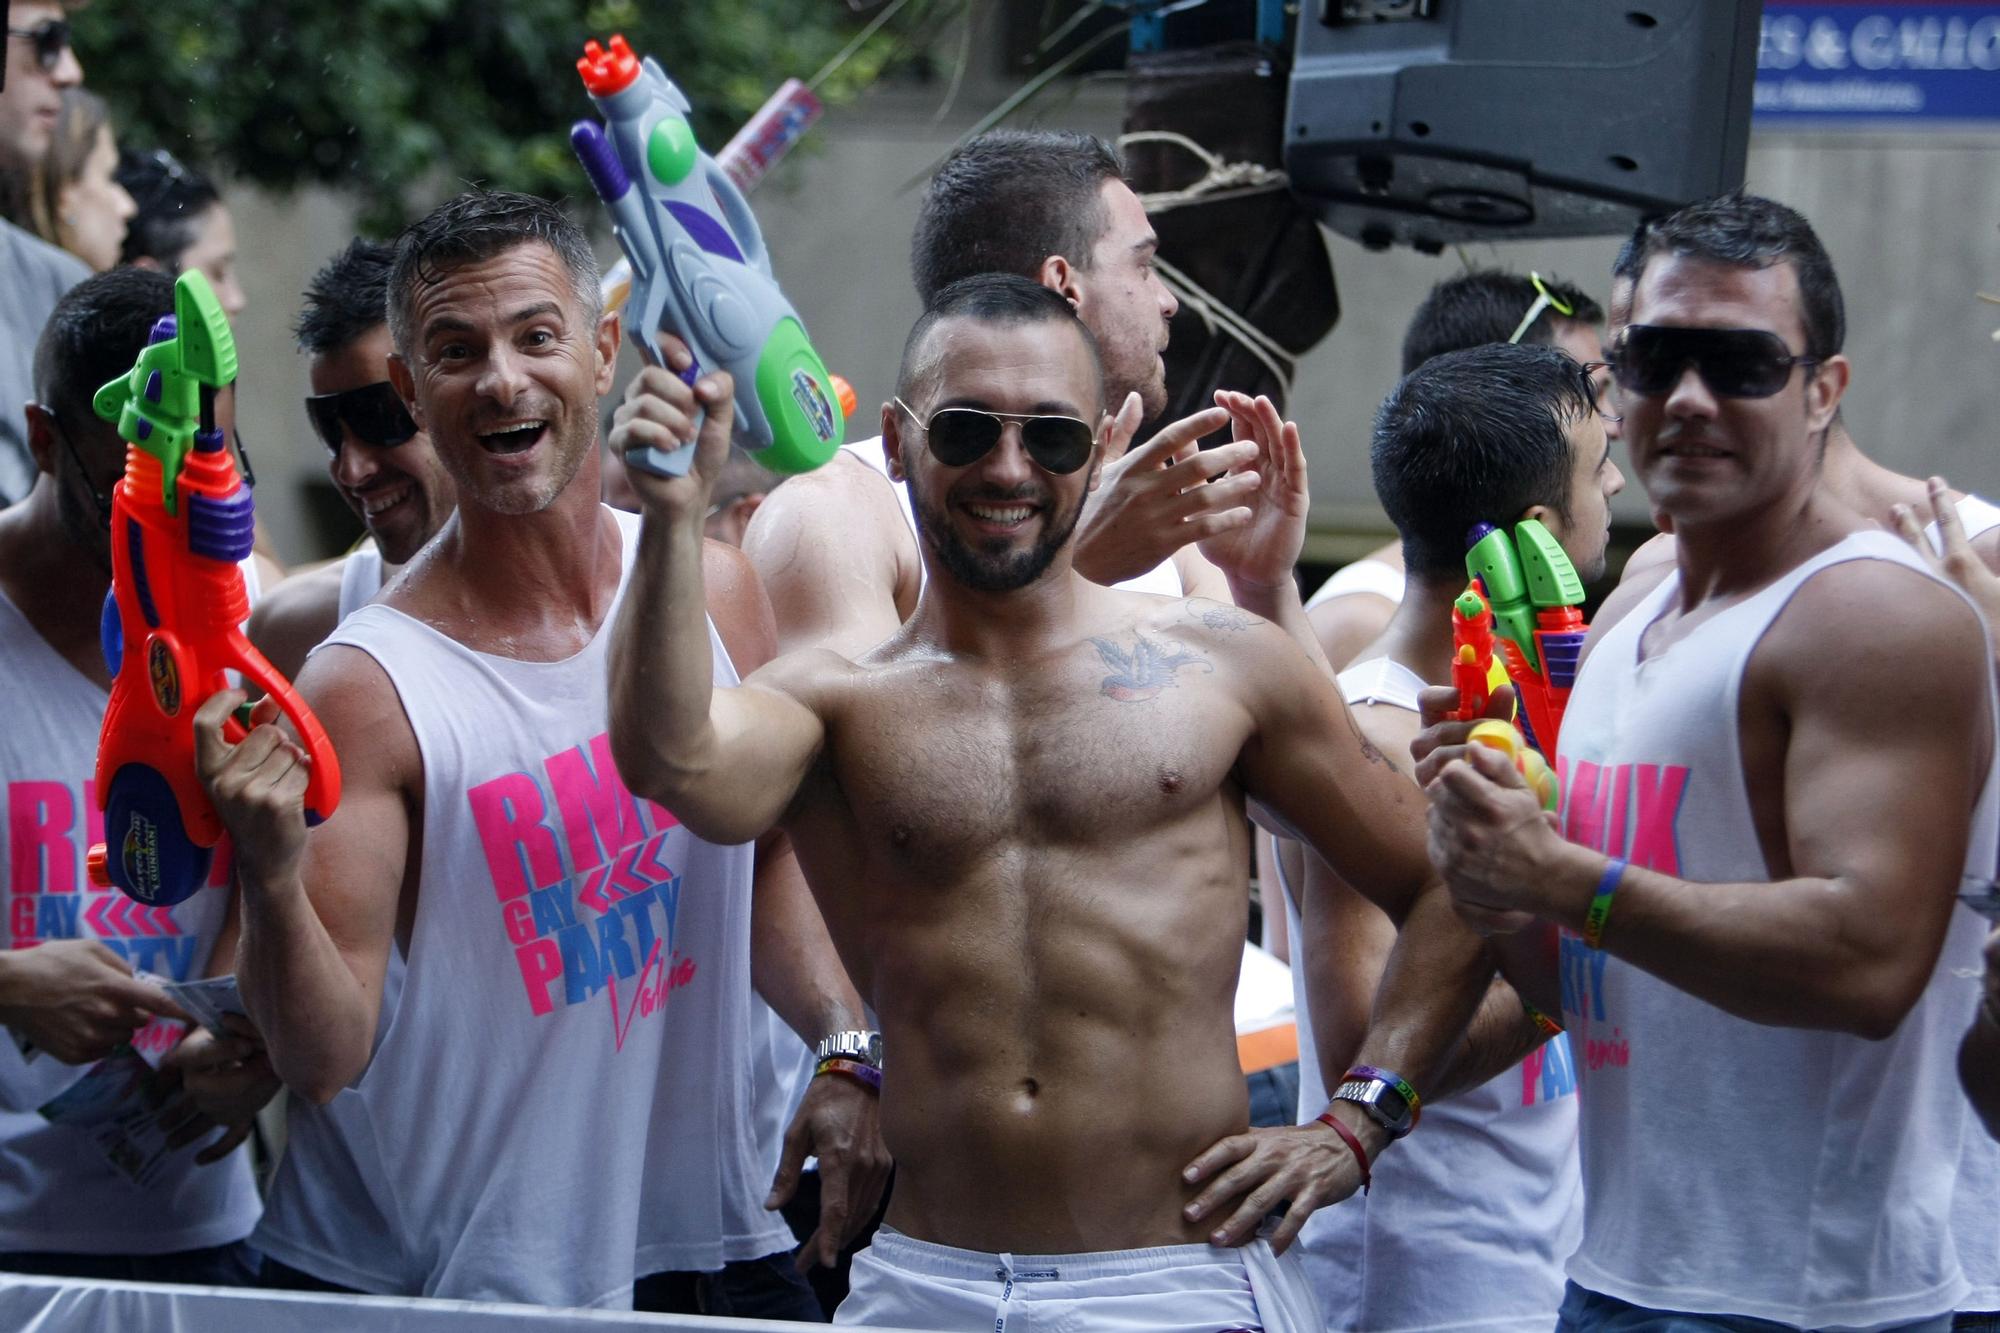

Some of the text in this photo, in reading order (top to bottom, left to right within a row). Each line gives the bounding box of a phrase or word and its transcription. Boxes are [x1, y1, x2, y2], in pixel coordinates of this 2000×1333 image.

[10, 895, 82, 939] GAY
[503, 878, 577, 946] GAY
[515, 876, 682, 1017] PARTY
